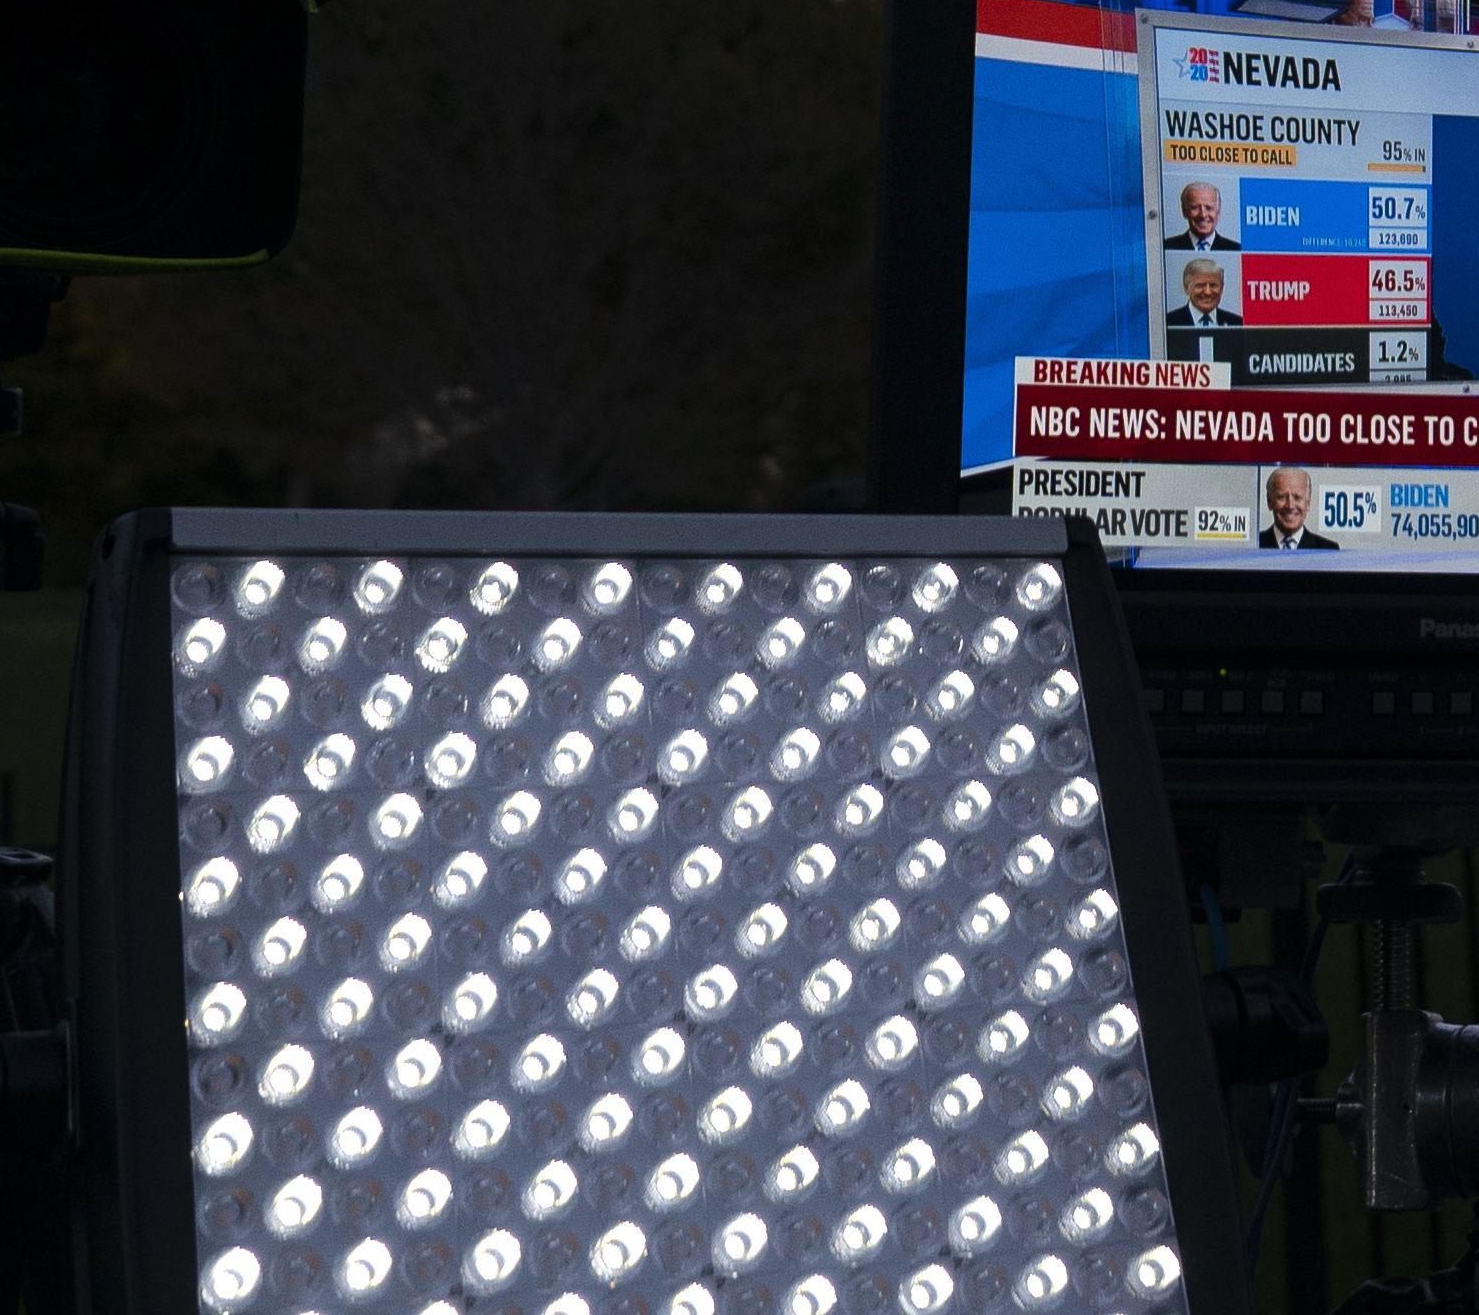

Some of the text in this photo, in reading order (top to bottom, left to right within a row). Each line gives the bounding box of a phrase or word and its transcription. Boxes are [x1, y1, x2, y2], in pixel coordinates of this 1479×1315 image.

[1189, 47, 1208, 64] 20
[1190, 65, 1208, 81] 20
[1223, 51, 1342, 91] NEVADA
[1165, 109, 1361, 146] WASHOE COUNTY
[1170, 145, 1293, 165] TOO CLOSE TO CALL
[1382, 140, 1426, 163] 95% IN
[1246, 206, 1300, 227] BIDEN
[1371, 196, 1426, 219] 50.7%
[1247, 281, 1311, 302] TRUMP
[1371, 268, 1426, 292] 46.5%
[1378, 304, 1419, 318] 113,450
[1378, 339, 1420, 363] 1.2%
[1033, 359, 1211, 387] BREAKING NEWS
[1248, 353, 1356, 374] CANDIDATES
[1029, 405, 1081, 437] NBC
[1089, 407, 1167, 440] NEWS:
[1175, 409, 1275, 442] NEVADA
[1283, 412, 1332, 444] TOO
[1340, 414, 1416, 446] CLOSE
[1423, 415, 1455, 447] TO
[1018, 468, 1146, 498] PRESIDENT
[1389, 483, 1450, 508] BIDEN
[1197, 509, 1247, 532] 92% IN
[1324, 490, 1378, 529] 50.5%
[1133, 509, 1189, 538] VOTE
[1195, 724, 1268, 735] INPUT SELECT
